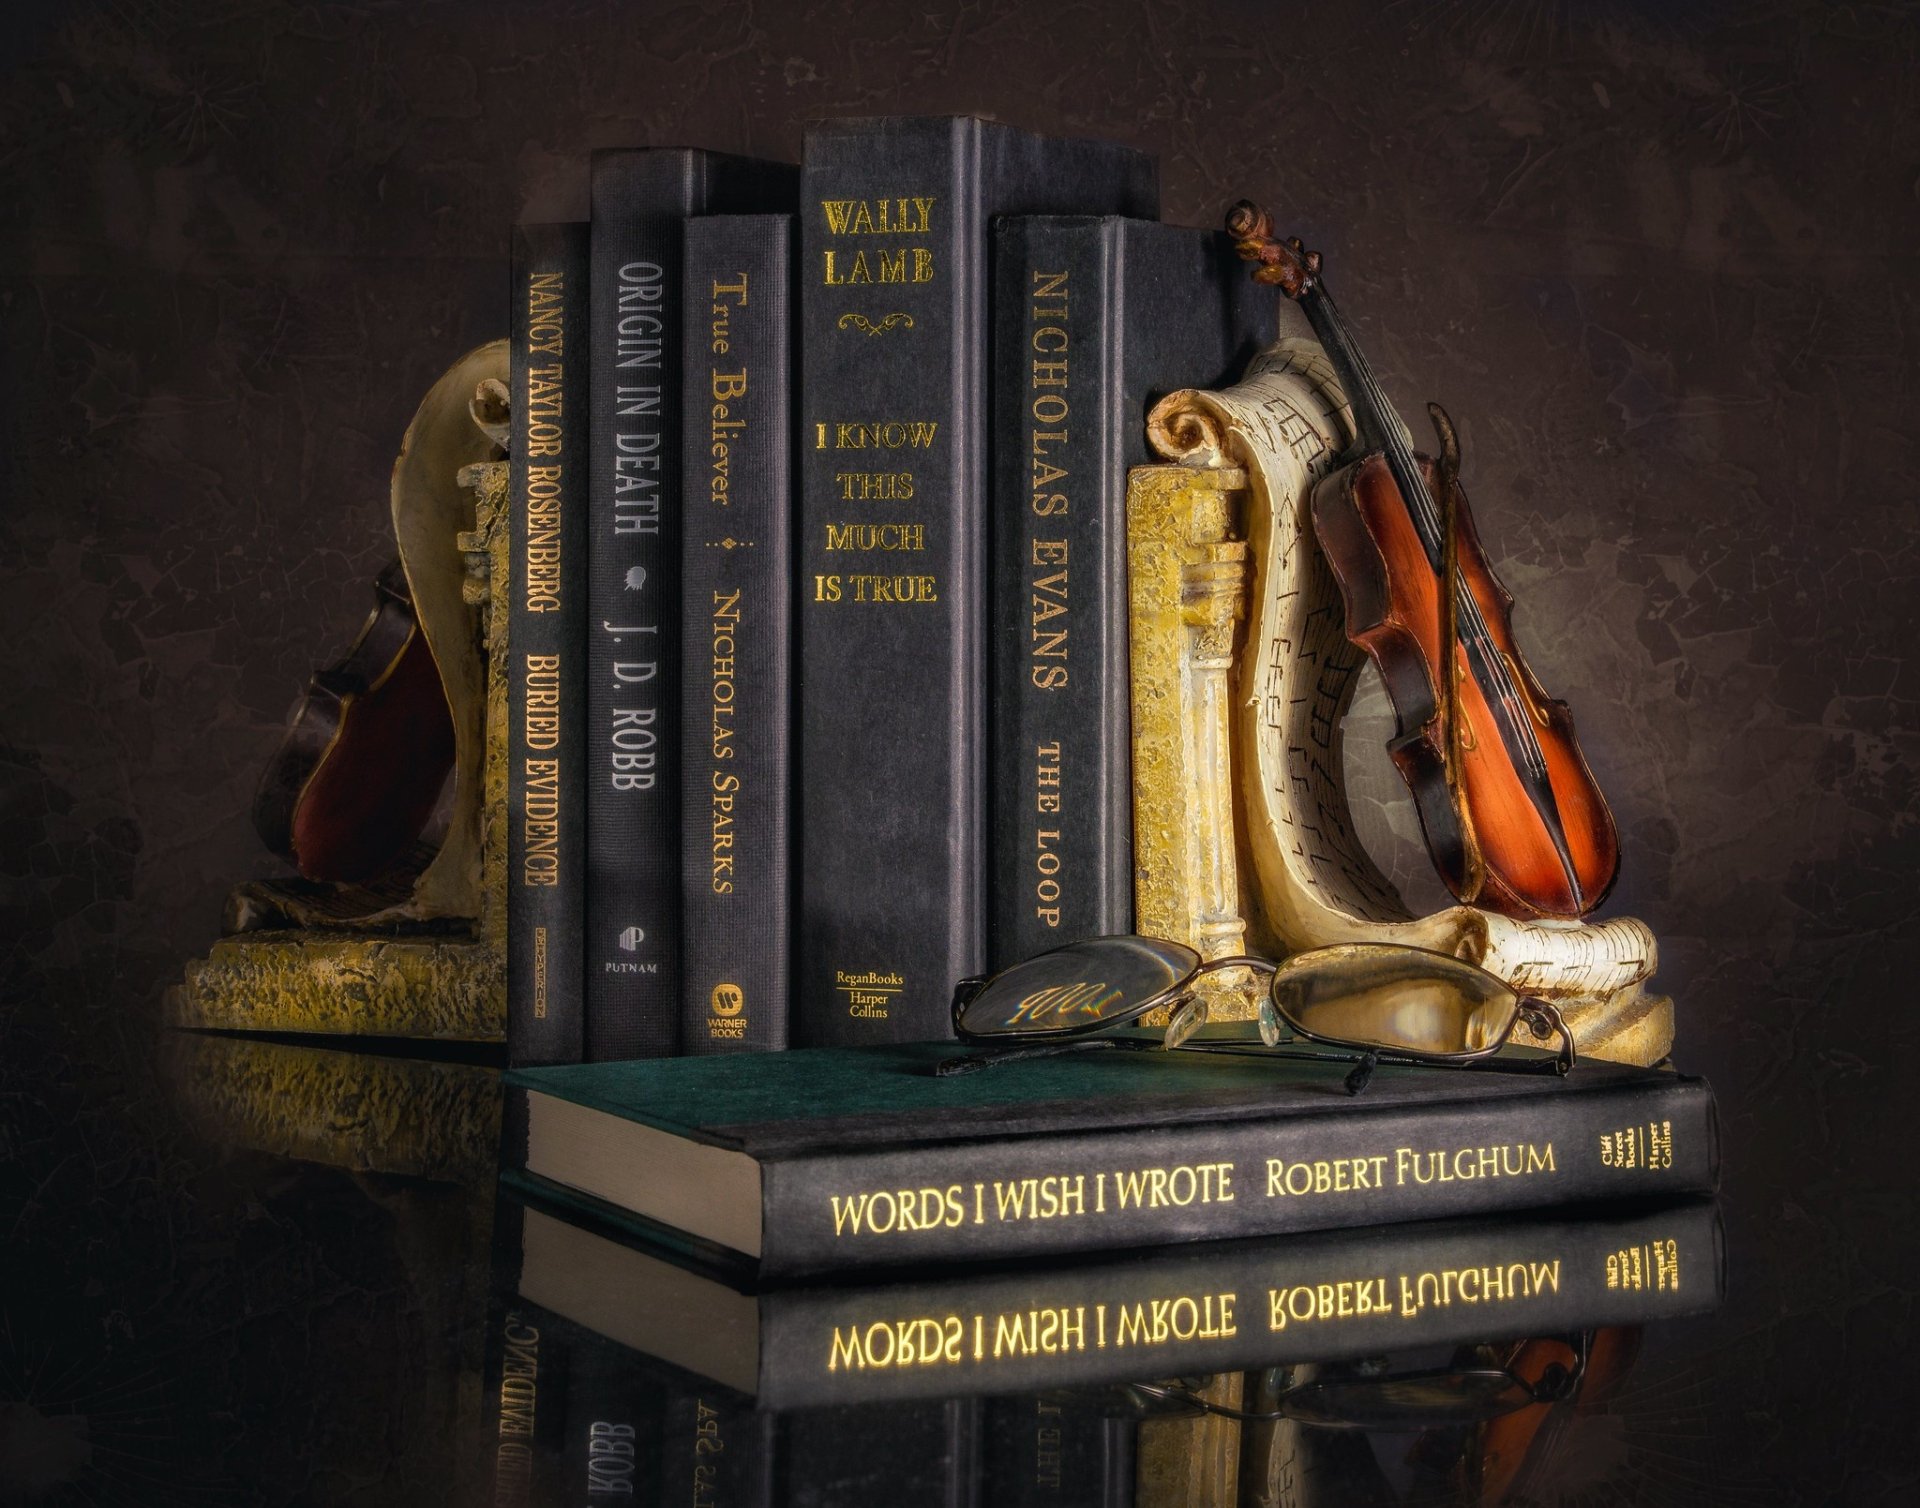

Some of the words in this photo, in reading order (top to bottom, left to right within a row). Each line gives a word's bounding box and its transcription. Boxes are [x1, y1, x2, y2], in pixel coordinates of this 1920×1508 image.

[822, 198, 937, 235] WALLY
[824, 248, 934, 286] LAMB
[529, 271, 563, 357] NANCY
[615, 261, 663, 369] ORIGIN
[711, 272, 748, 356] True
[528, 363, 562, 458] TAYLOR
[615, 385, 661, 416] IN
[1031, 270, 1069, 517] NICHOLAS
[711, 367, 747, 506] Believer
[816, 423, 826, 449] I
[836, 423, 938, 449] KNOW
[614, 432, 660, 535] DEATH
[837, 472, 913, 500] THIS
[526, 464, 561, 614] ROSENBERG
[826, 525, 924, 551] MUCH
[815, 576, 841, 602] IS
[849, 576, 937, 602] TRUE
[603, 620, 657, 643] J.
[1031, 538, 1069, 690] EVANS
[613, 661, 657, 689] D.
[713, 588, 741, 760] NICHOLAS
[525, 653, 560, 750] BURIED
[611, 708, 656, 791] ROBB
[1037, 742, 1060, 813] THE
[524, 757, 559, 887] EVIDENCE
[713, 770, 741, 895] SPARKS
[1037, 829, 1060, 928] LOOP
[605, 962, 657, 974] PUTNAM
[836, 970, 904, 986] ReganBooks
[849, 991, 889, 1007] Harper
[849, 1005, 889, 1019] Collins
[707, 1018, 747, 1029] WARNER
[710, 1029, 743, 1039] BOOKS
[1601, 1134, 1613, 1166] Cliff
[1626, 1127, 1636, 1168] Books
[1650, 1122, 1662, 1170] Harper
[1662, 1120, 1672, 1169] Collins
[830, 1184, 965, 1237] WORDS
[973, 1183, 986, 1225] I
[993, 1174, 1086, 1222] WISH
[1095, 1173, 1107, 1213] I
[1114, 1162, 1236, 1210] WROTE
[1265, 1156, 1389, 1199] ROBERT
[1396, 1141, 1558, 1186] FULGHUM
